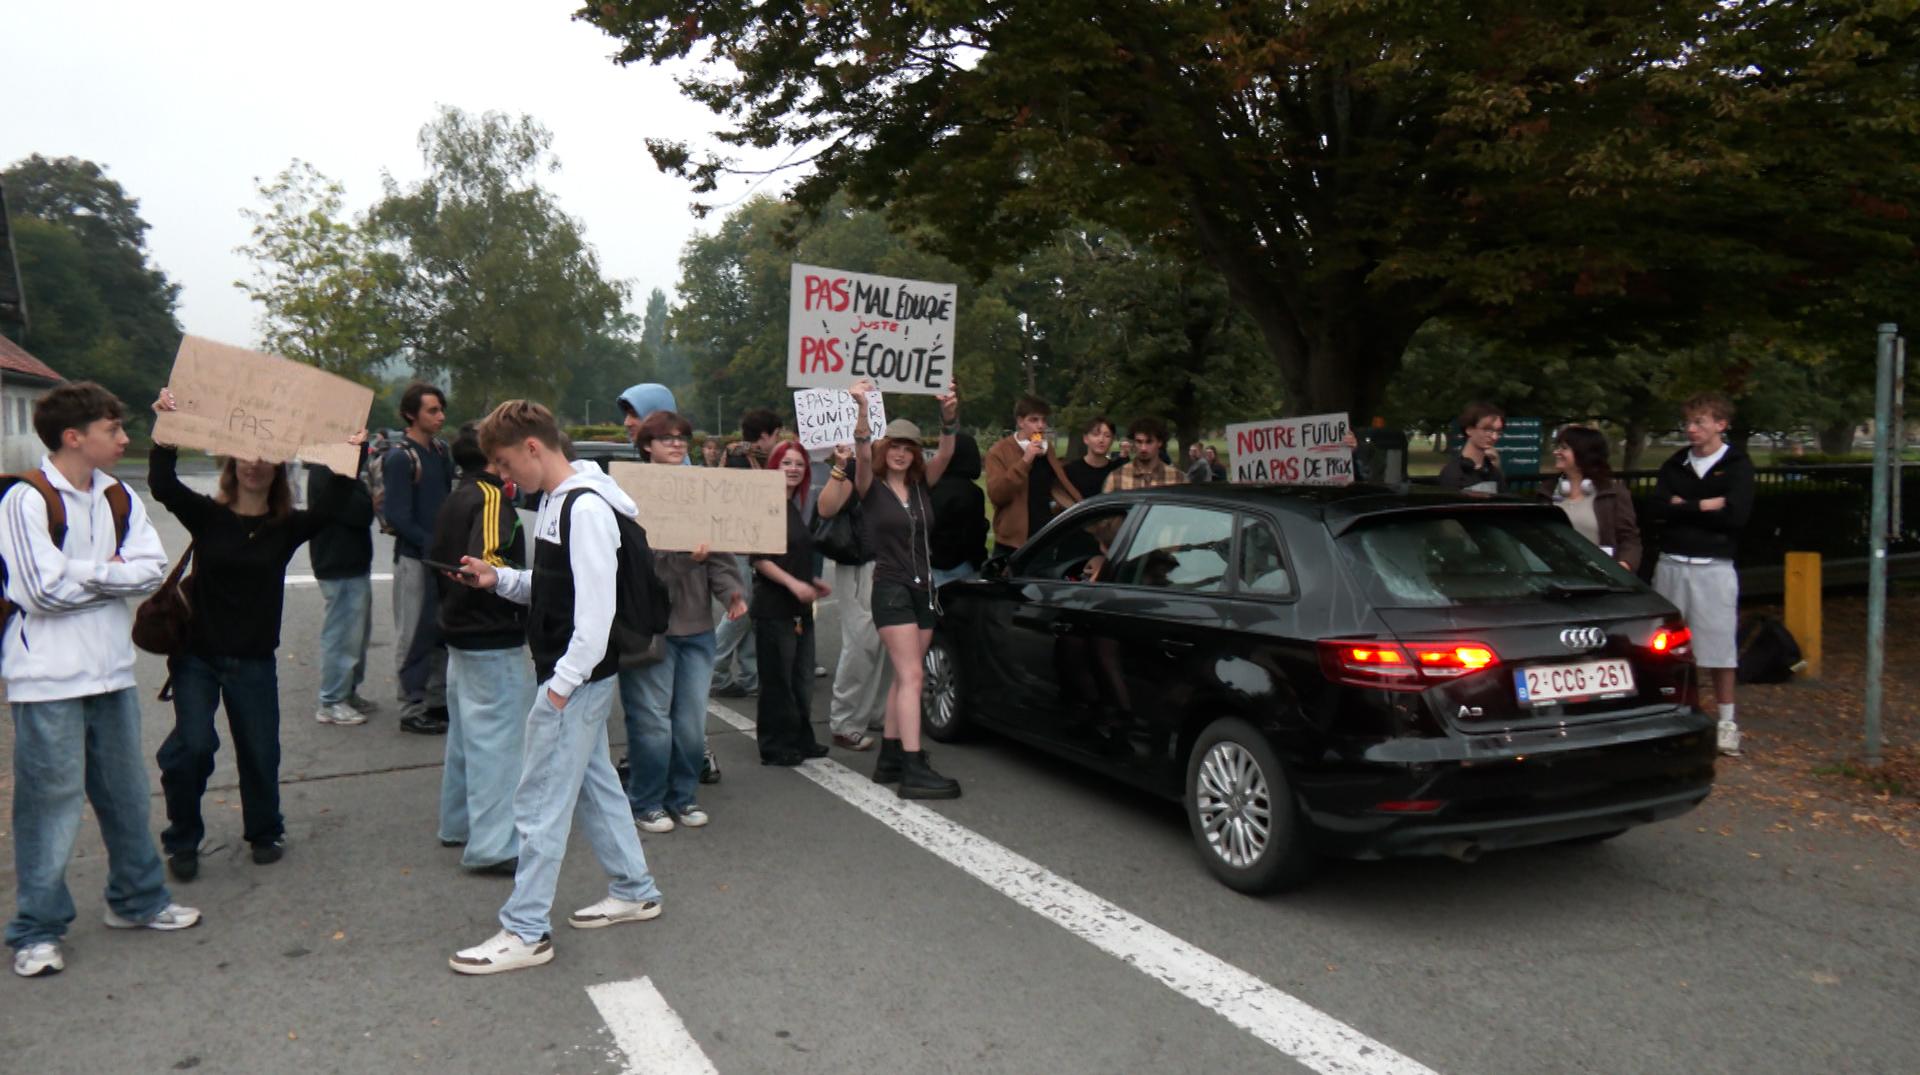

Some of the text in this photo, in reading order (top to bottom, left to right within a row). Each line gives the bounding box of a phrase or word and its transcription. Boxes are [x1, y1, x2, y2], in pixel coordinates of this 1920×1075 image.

[804, 275, 849, 311] PAS
[800, 336, 844, 374] PAS
[851, 333, 946, 388] ÉCOUTÉ
[806, 391, 857, 409] PAS D
[229, 407, 274, 440] PAS
[1237, 421, 1346, 456] NOTRE FUTUR
[1270, 456, 1299, 480] PAS
[1304, 458, 1321, 478] DE
[1458, 704, 1483, 718] A3
